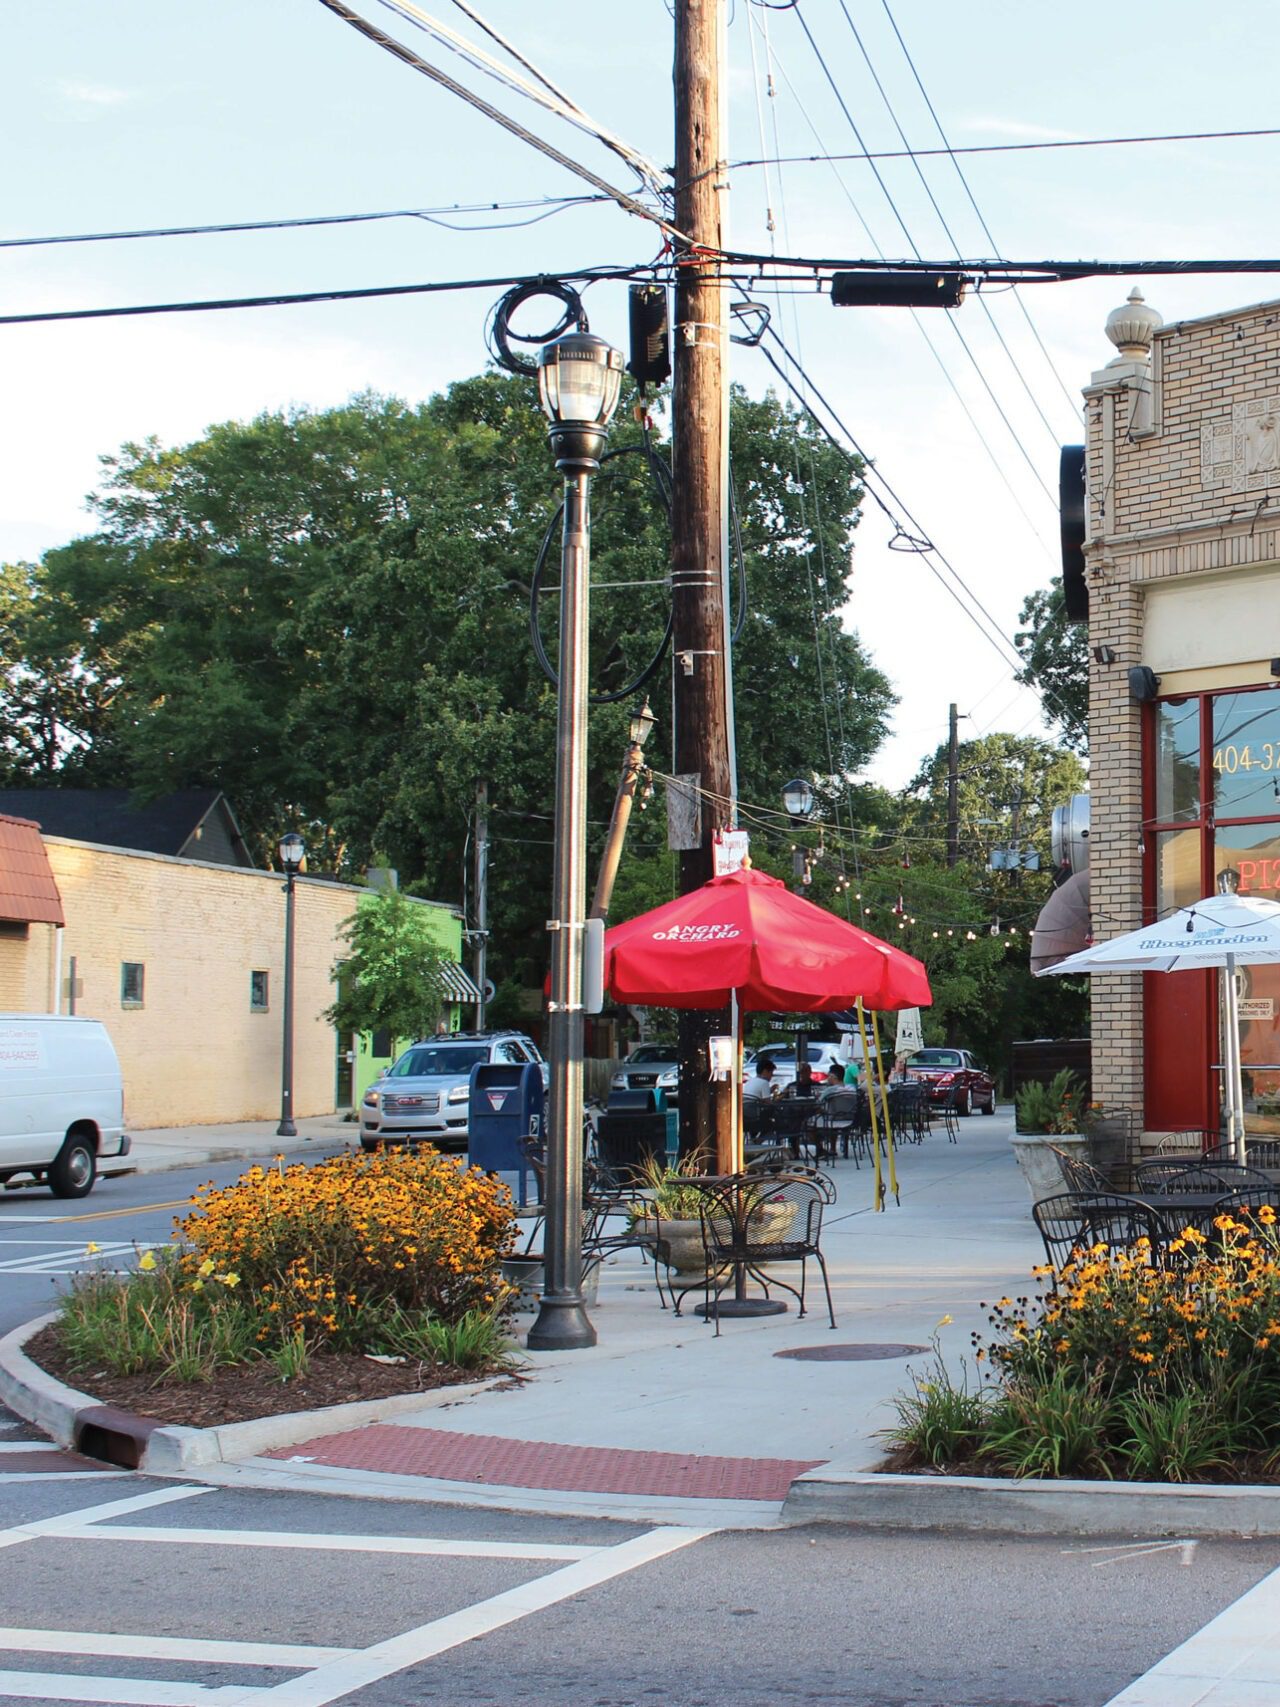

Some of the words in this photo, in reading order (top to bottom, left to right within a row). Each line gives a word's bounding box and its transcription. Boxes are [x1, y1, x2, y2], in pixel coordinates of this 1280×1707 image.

[667, 923, 736, 933] ANGRY
[651, 929, 741, 941] ORCHARD
[1138, 934, 1269, 949] Hoegaarden
